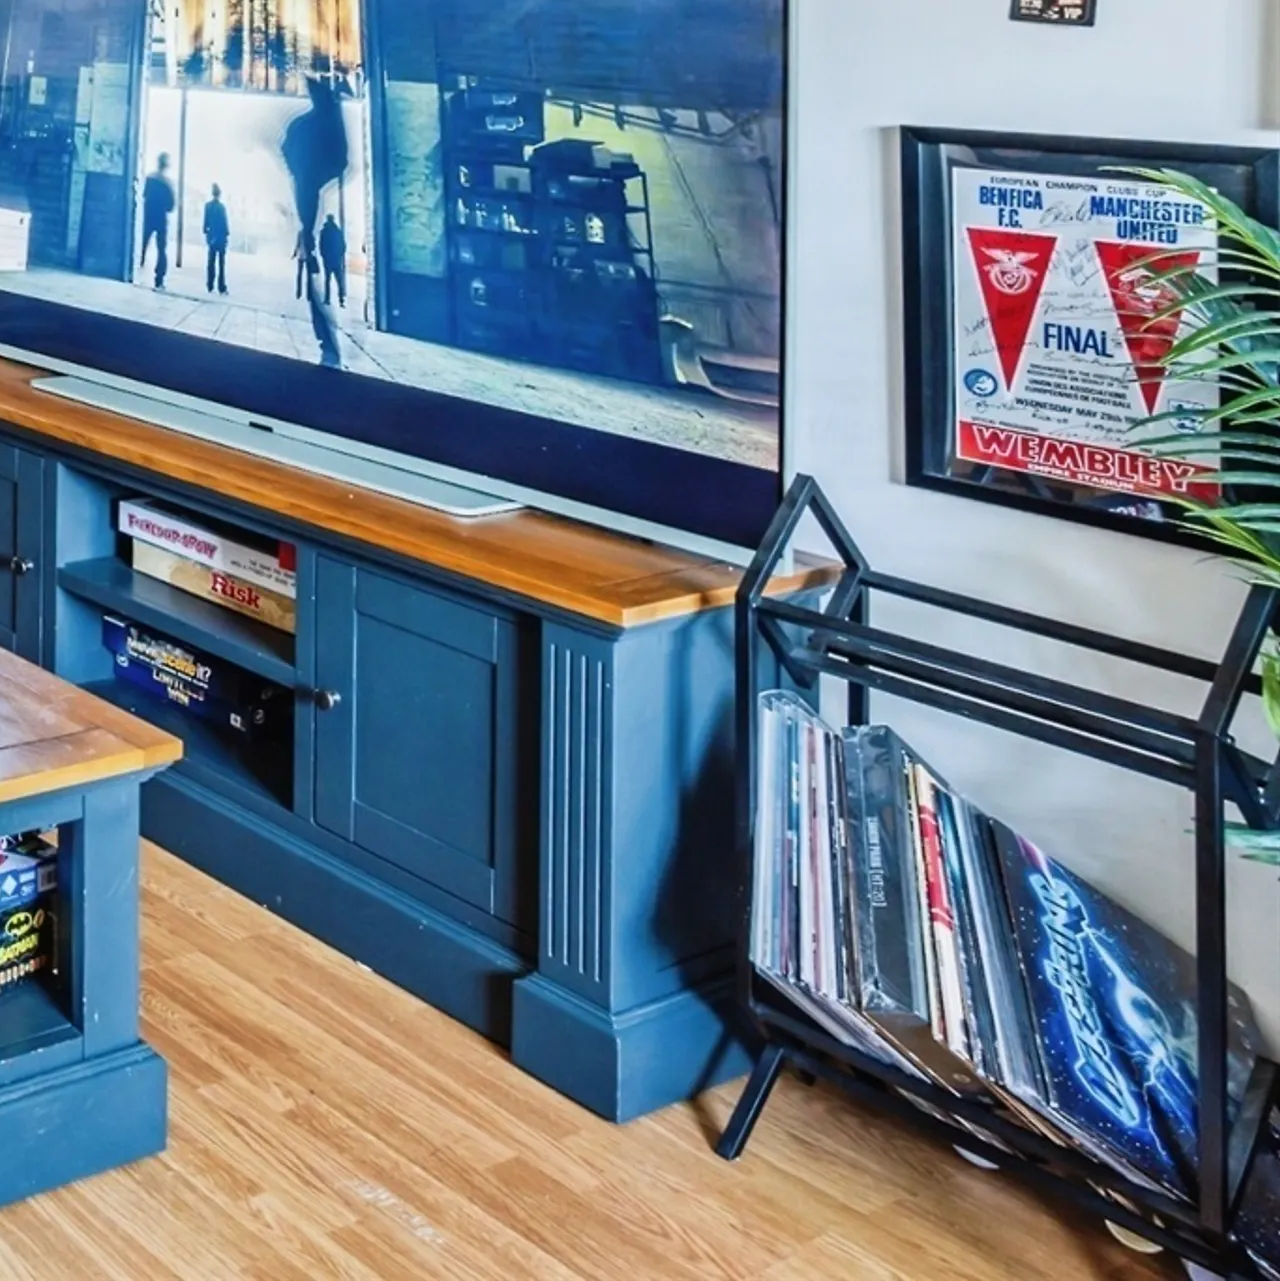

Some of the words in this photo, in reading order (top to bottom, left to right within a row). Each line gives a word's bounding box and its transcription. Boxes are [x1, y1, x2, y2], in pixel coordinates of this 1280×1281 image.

[978, 185, 1044, 211] BENFICA
[990, 176, 1039, 188] EUROPEAN
[1045, 180, 1098, 193] CHAMPION
[1106, 186, 1139, 197] CLUBS
[998, 209, 1024, 230] F.C.
[1090, 195, 1204, 226] MANCHESTER
[1116, 220, 1179, 245] UNITED
[1043, 322, 1115, 358] FINAL
[1028, 378, 1052, 388] UNION
[1053, 381, 1068, 390] DES
[1070, 384, 1127, 400] ASSOCIATIONS
[1015, 397, 1073, 414] WEDNESDAY
[1076, 407, 1098, 419] MAY
[1091, 395, 1132, 410] FOOTBALL
[972, 424, 1196, 493] WEMBLEY
[1077, 473, 1135, 491] STADIUM
[211, 571, 261, 609] Risk
[868, 846, 882, 869] PARK
